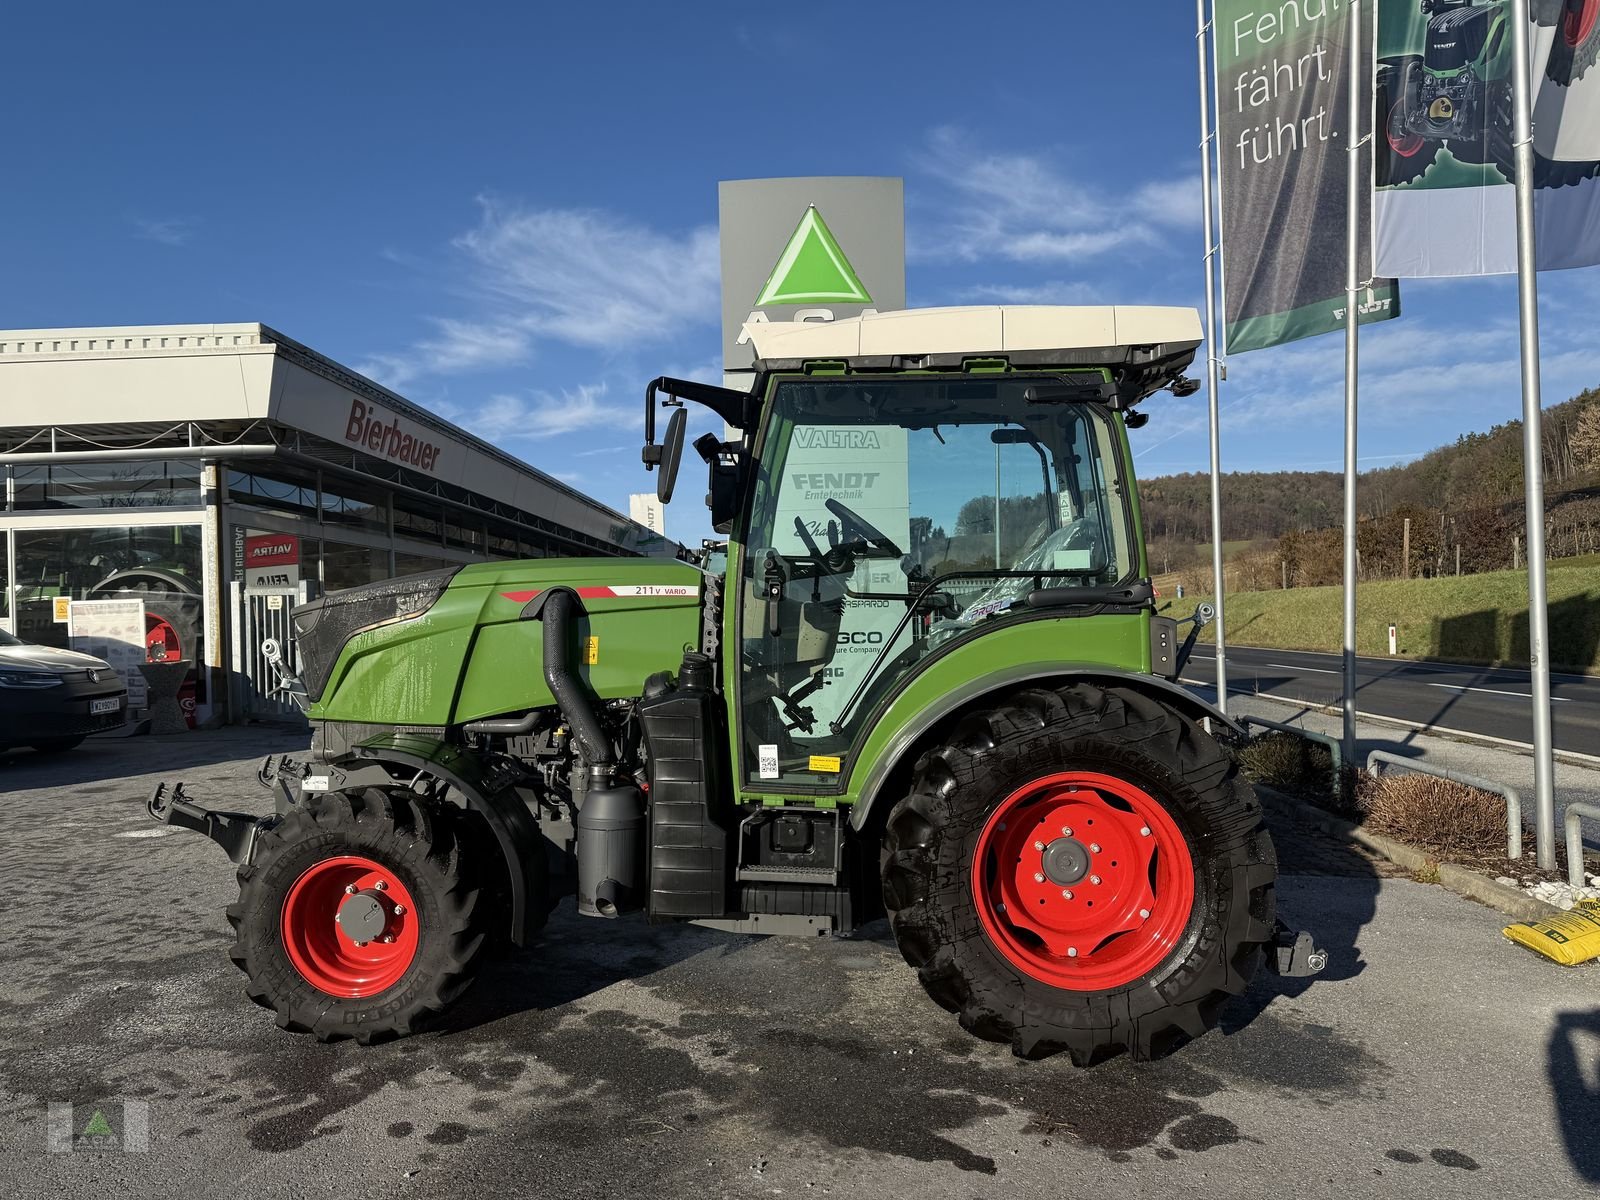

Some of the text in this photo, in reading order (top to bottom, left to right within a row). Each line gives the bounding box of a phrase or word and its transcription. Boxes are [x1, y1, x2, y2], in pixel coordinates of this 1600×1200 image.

[1234, 44, 1332, 113] fährt,
[1236, 109, 1338, 170] führt.
[1332, 298, 1392, 320] FNDT
[345, 399, 441, 472] Bierbauer
[794, 427, 880, 449] VALTRA
[791, 473, 880, 490] FENDT
[804, 489, 864, 500] Erntetechnik
[844, 600, 889, 608] ASPARDO
[837, 632, 883, 645] GCO
[849, 646, 880, 654] Company
